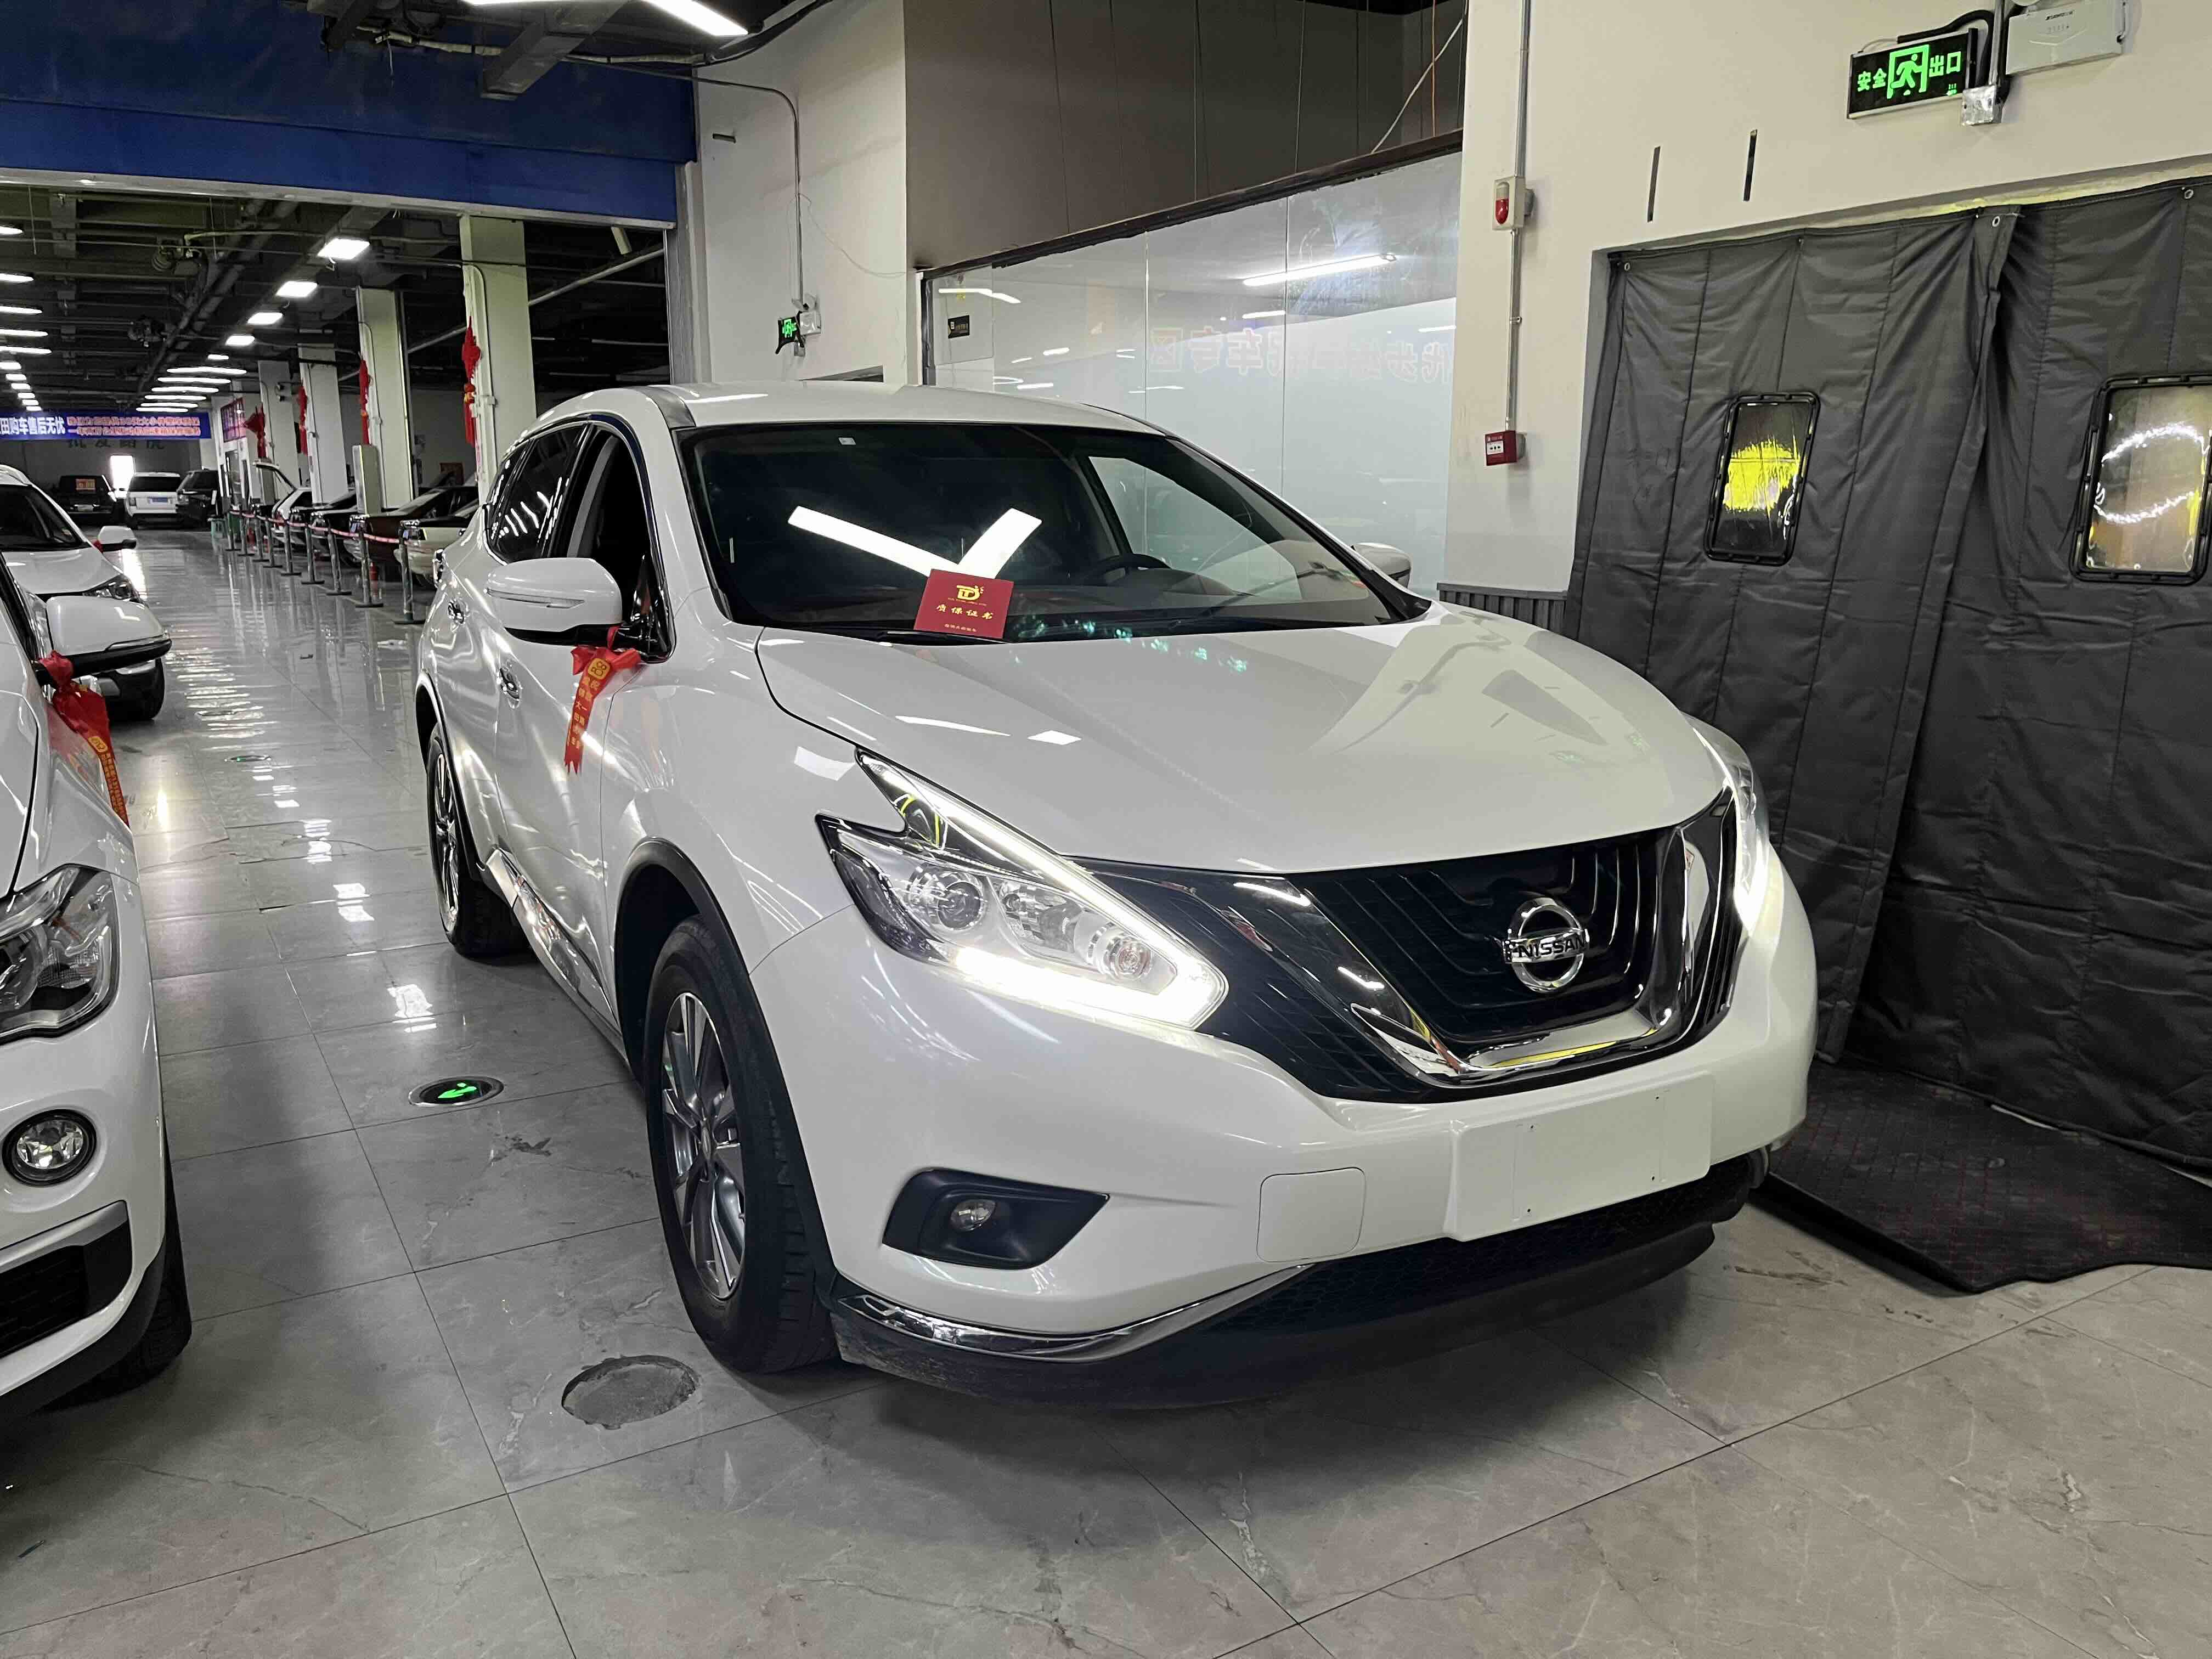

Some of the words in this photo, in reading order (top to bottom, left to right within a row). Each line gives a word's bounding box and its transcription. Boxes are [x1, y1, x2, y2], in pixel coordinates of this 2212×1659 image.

[1857, 68, 1887, 92] 安全
[1928, 50, 1962, 77] 出口
[0, 416, 66, 435] 田购车售后无忧
[1517, 934, 1586, 958] NISSAN
